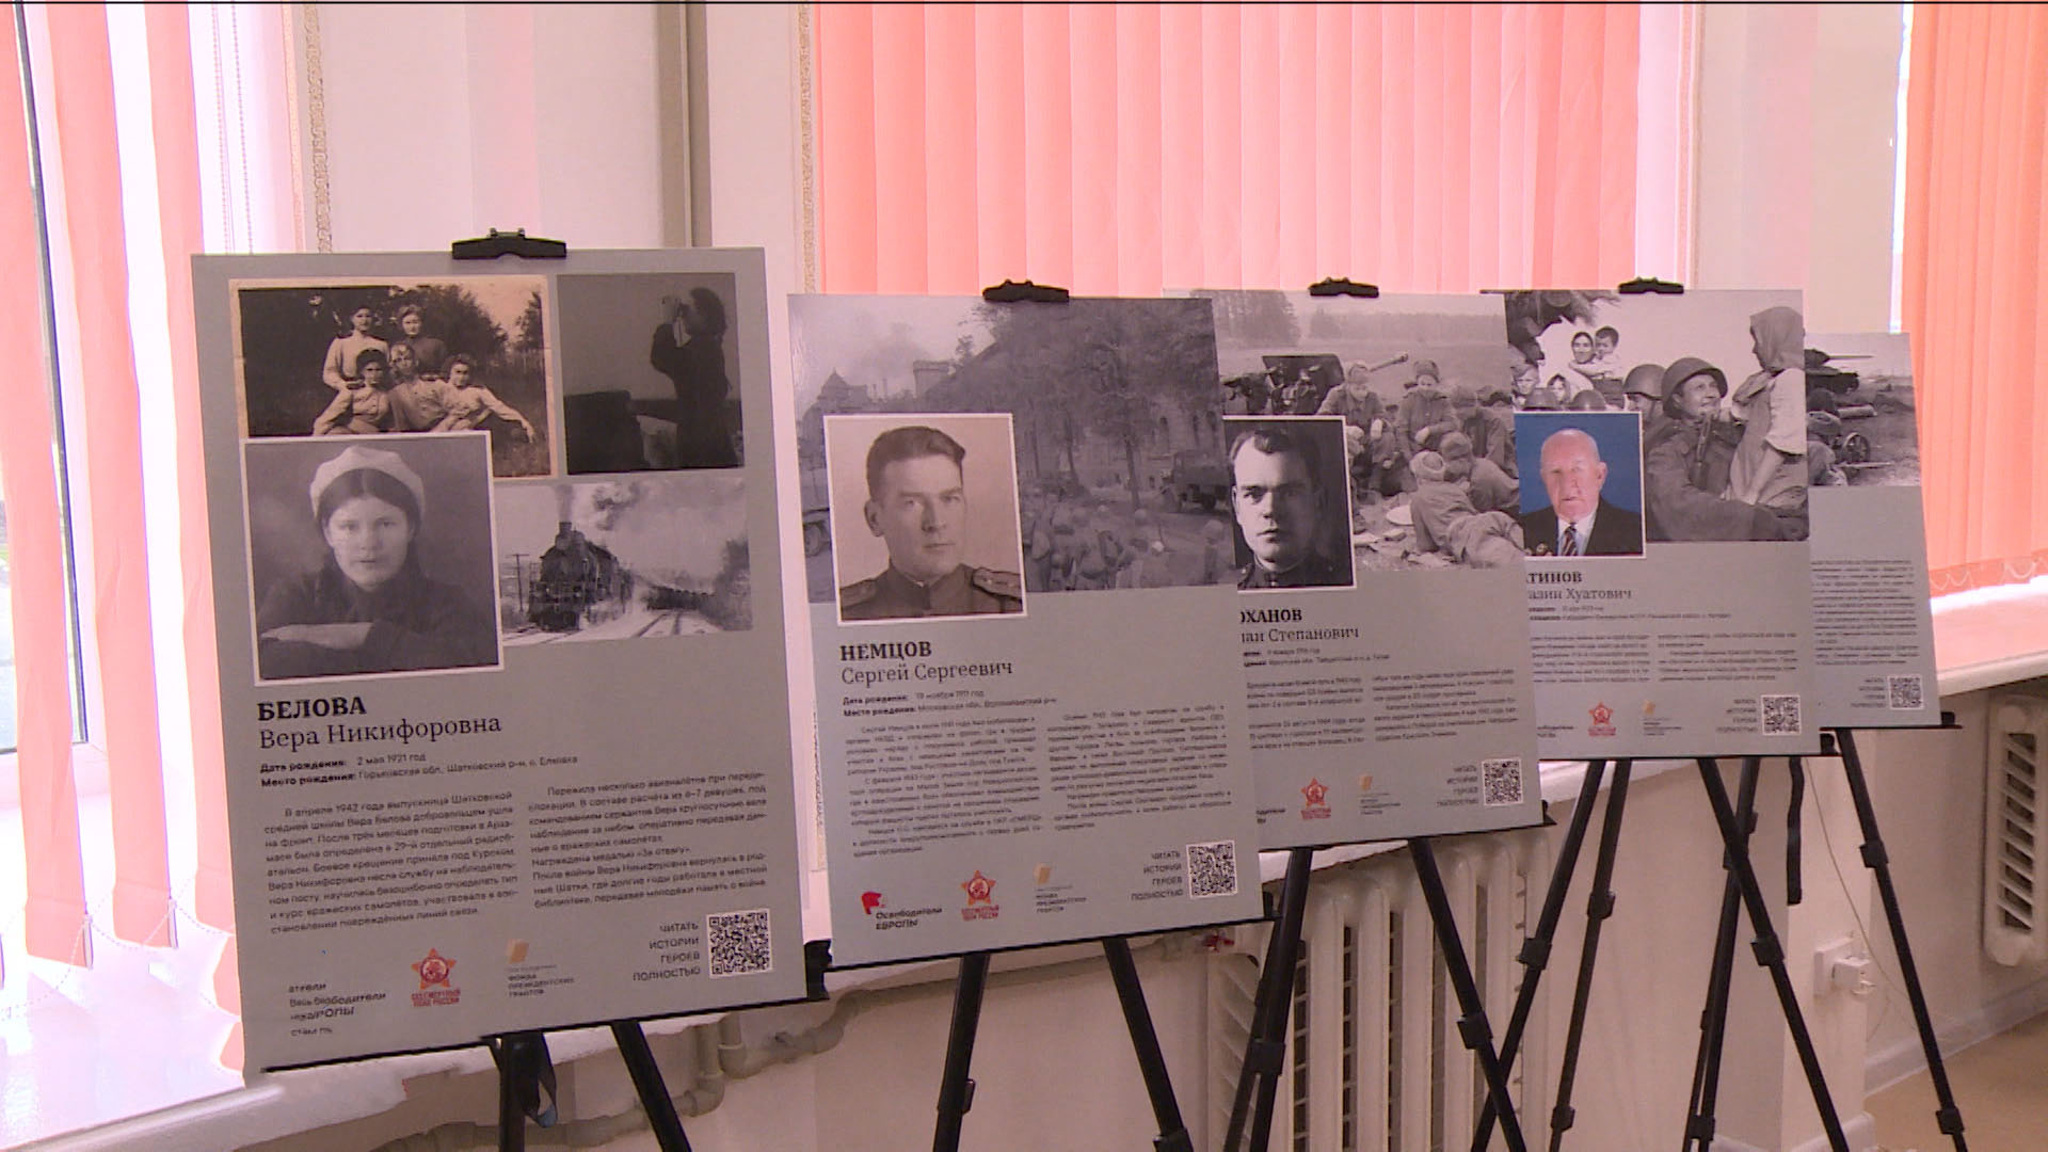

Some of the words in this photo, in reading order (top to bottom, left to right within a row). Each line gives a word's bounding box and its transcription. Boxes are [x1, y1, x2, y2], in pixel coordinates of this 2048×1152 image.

[1566, 588, 1632, 603] Хуатович
[1268, 627, 1359, 642] Степанович
[840, 641, 932, 661] НЕМЦОВ
[842, 664, 909, 688] Сергей
[914, 662, 1013, 682] Сергеевич
[258, 696, 366, 721] БЕЛОВА
[260, 728, 320, 752] Вера
[328, 718, 502, 744] Никифоровна
[660, 922, 699, 932] ЧИТАТЬ
[649, 937, 699, 949] ИСТОРИИ
[660, 951, 700, 963] ГЕРОЕВ
[632, 967, 701, 981] ПОЛНОСТЬЮ
